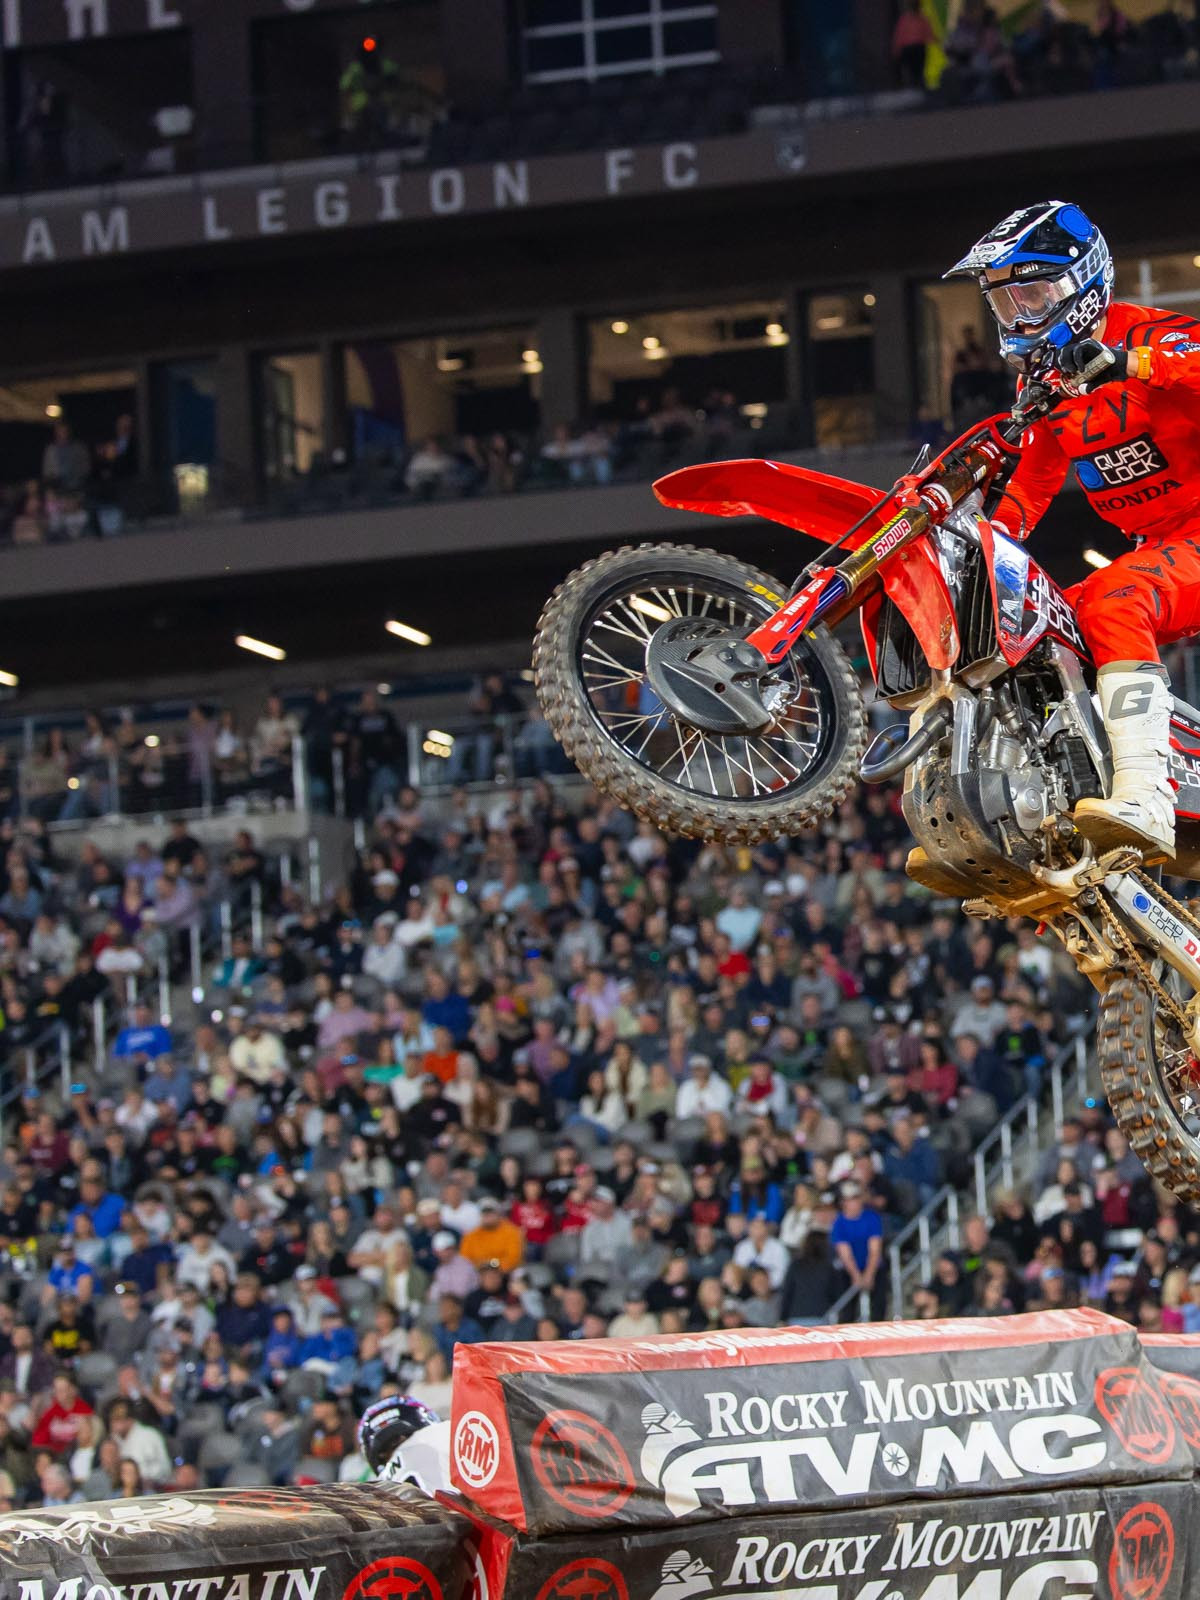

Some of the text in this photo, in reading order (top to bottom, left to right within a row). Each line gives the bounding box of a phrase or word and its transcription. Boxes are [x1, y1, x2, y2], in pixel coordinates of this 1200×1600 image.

[202, 161, 529, 241] LEGION
[605, 142, 699, 195] FC
[1066, 289, 1098, 325] QUAD
[1071, 297, 1103, 334] LOCK
[1094, 440, 1150, 470] QUAD
[1102, 453, 1160, 485] LOCK
[1094, 478, 1184, 513] HONDA
[873, 519, 911, 560] SHOWA
[1108, 681, 1155, 720] G
[1148, 911, 1180, 943] LOCK
[1152, 905, 1184, 936] QUAD
[703, 1372, 1078, 1438] ROCKY MOUNTAIN
[661, 1414, 1106, 1518] ATV MC
[722, 1510, 1106, 1587] ROCKY MOUNTAIN
